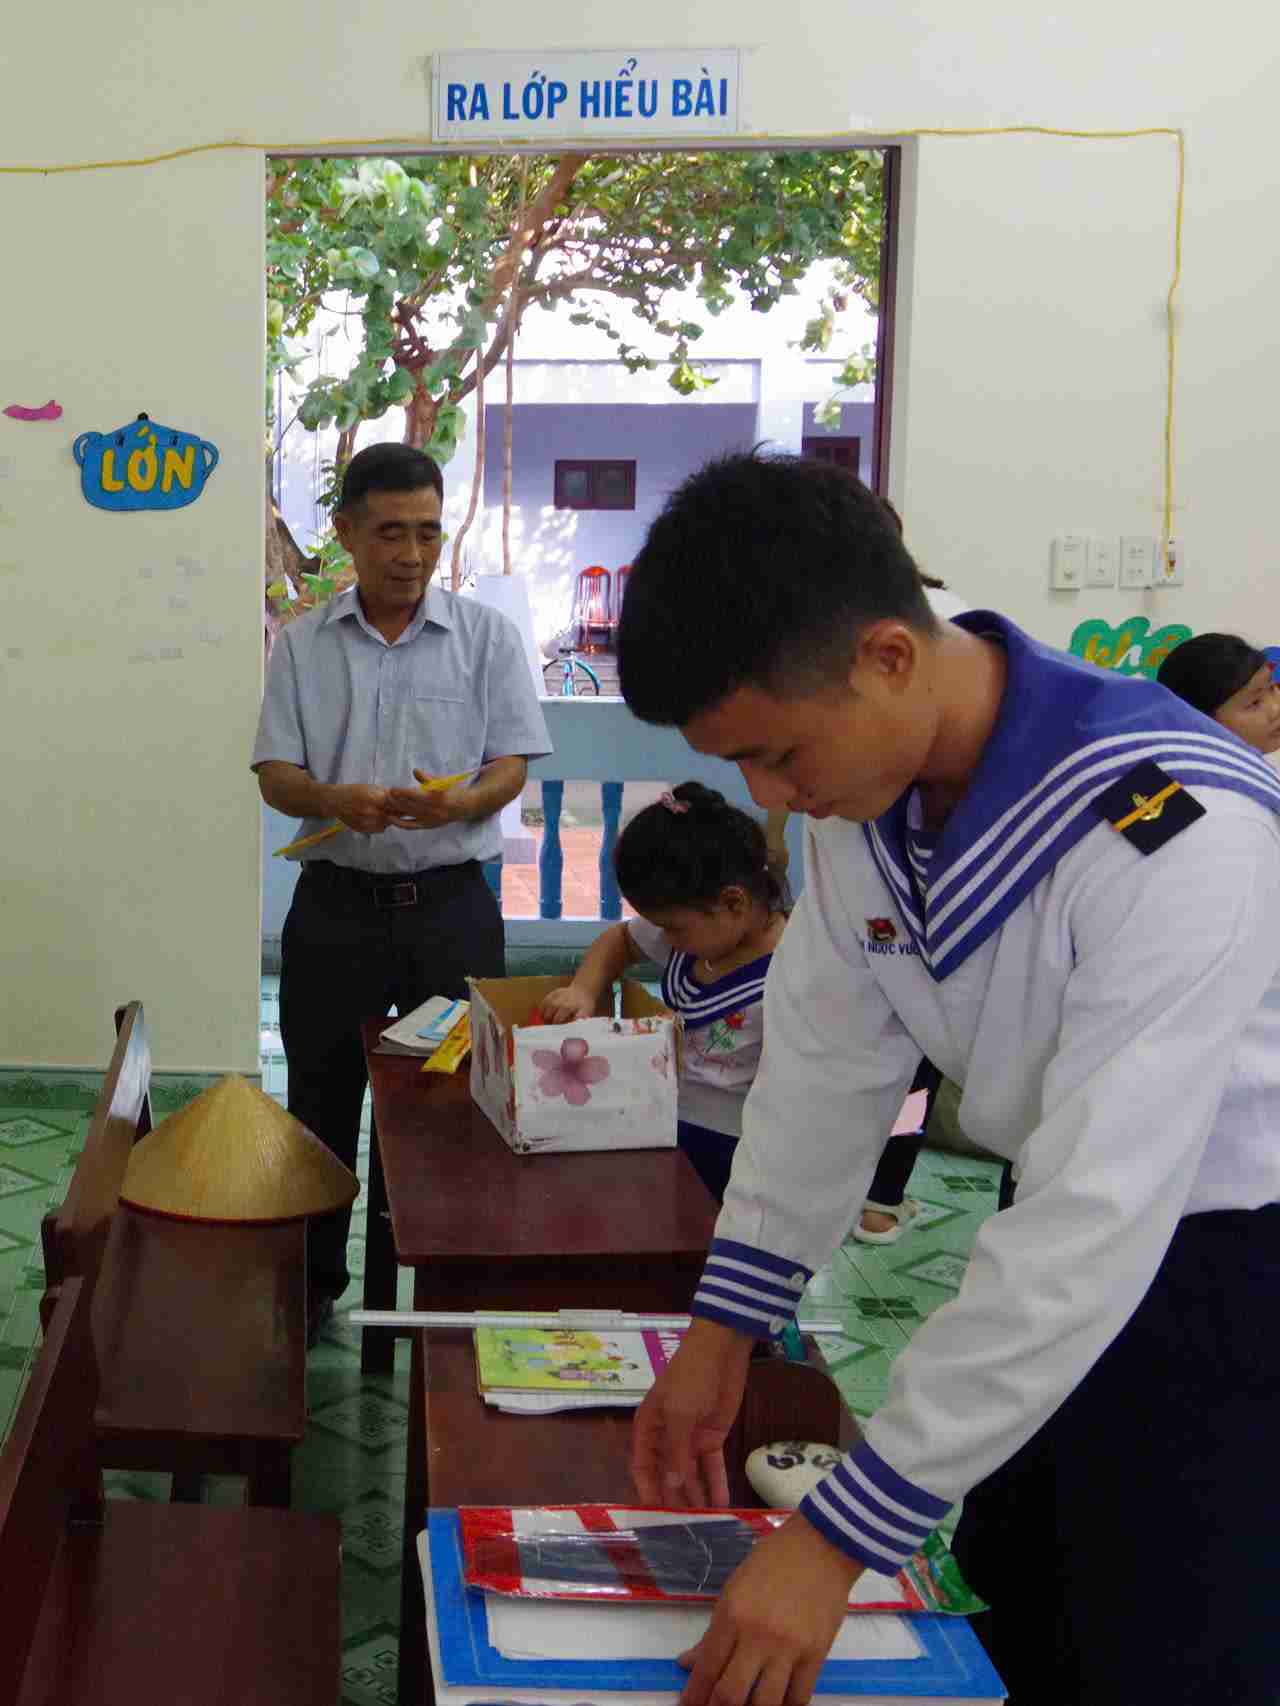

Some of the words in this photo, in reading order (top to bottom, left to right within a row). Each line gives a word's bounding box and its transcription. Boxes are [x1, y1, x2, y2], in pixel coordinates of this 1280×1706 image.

[447, 82, 490, 121] RA
[503, 69, 568, 120] LỚP
[580, 56, 658, 118] HIỂU
[672, 66, 728, 117] BÀI
[100, 425, 196, 494] LỚN
